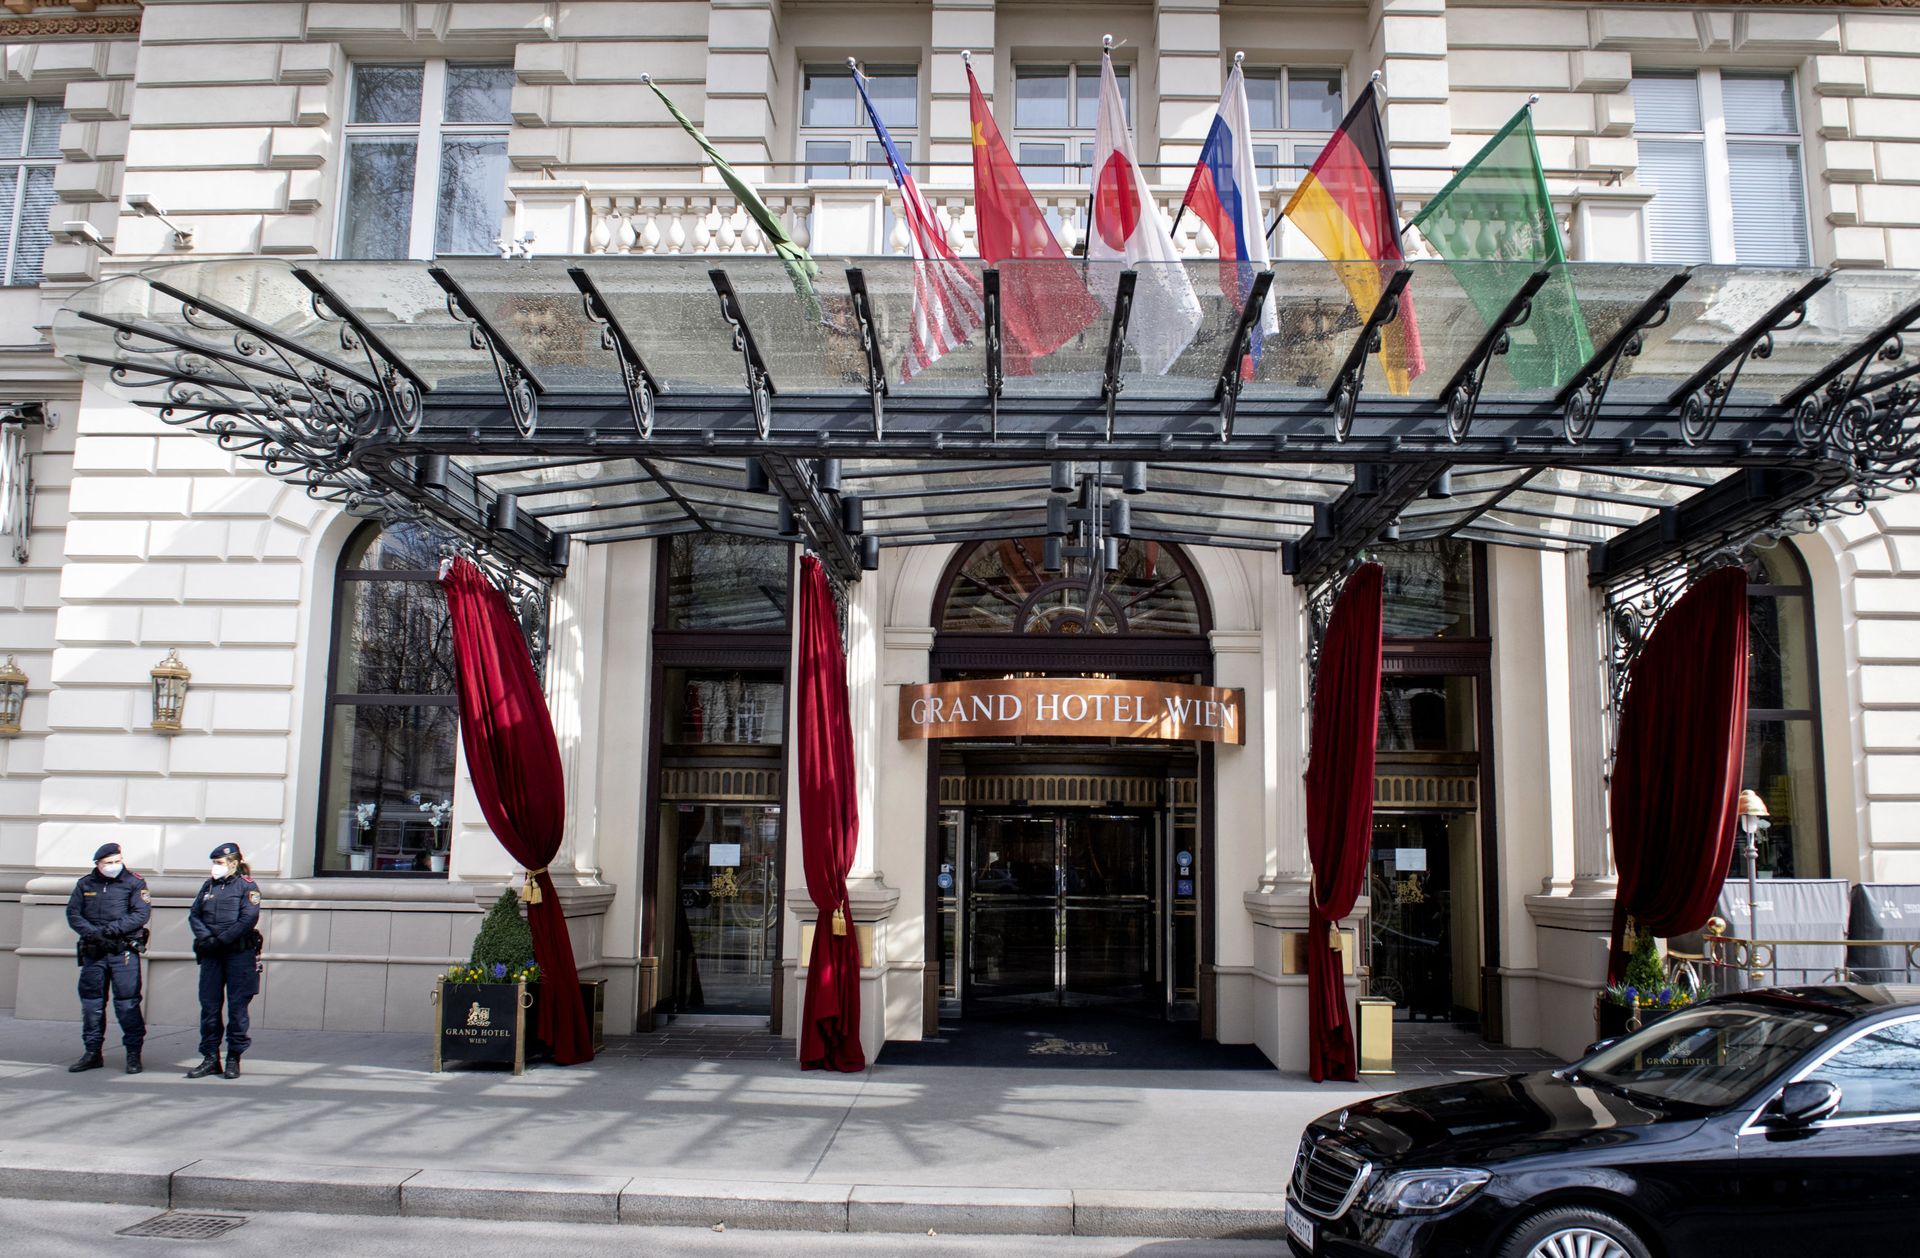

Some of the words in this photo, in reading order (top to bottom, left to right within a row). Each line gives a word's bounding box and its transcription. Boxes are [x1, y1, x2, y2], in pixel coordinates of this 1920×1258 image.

[911, 694, 1023, 725] GRAND
[1035, 694, 1154, 724] HOTEL
[1165, 697, 1235, 729] WIEN
[445, 1028, 478, 1036] GRAND
[481, 1029, 511, 1037] HOTEL
[1646, 1057, 1679, 1065] GRAND
